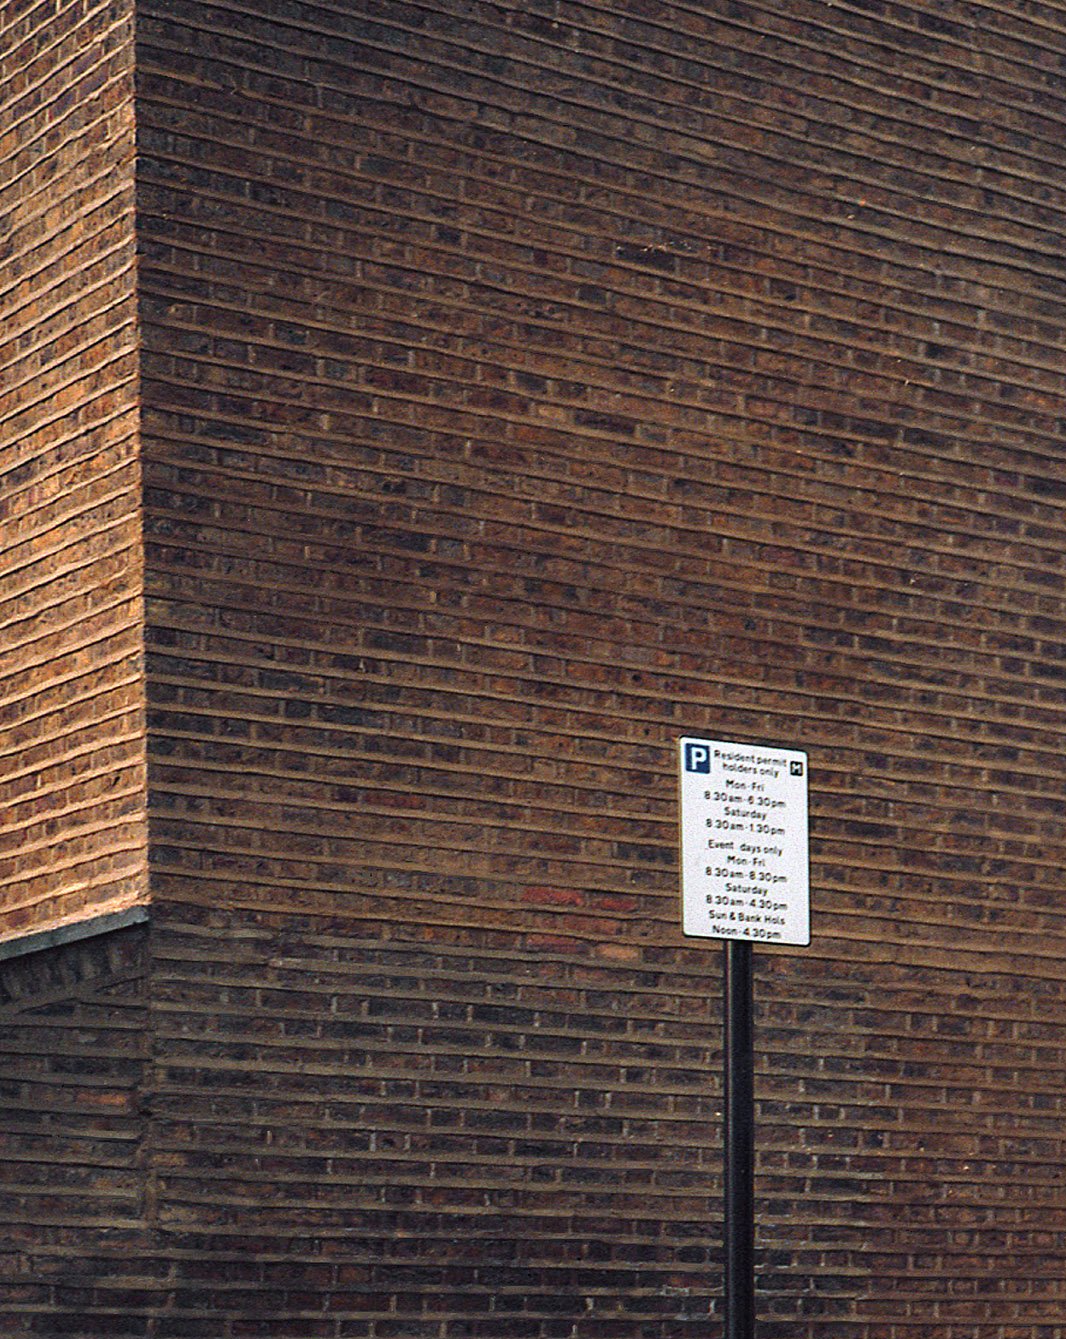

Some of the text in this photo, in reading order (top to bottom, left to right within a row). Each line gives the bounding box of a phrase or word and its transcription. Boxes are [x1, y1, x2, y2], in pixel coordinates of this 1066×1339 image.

[691, 746, 707, 770] P
[714, 749, 787, 767] Resident permit
[722, 762, 779, 778] holders only
[724, 806, 767, 820] Saturday
[708, 839, 783, 857] Event days only
[725, 882, 768, 897] Saturday
[708, 909, 786, 925] Sun & Bank Hols
